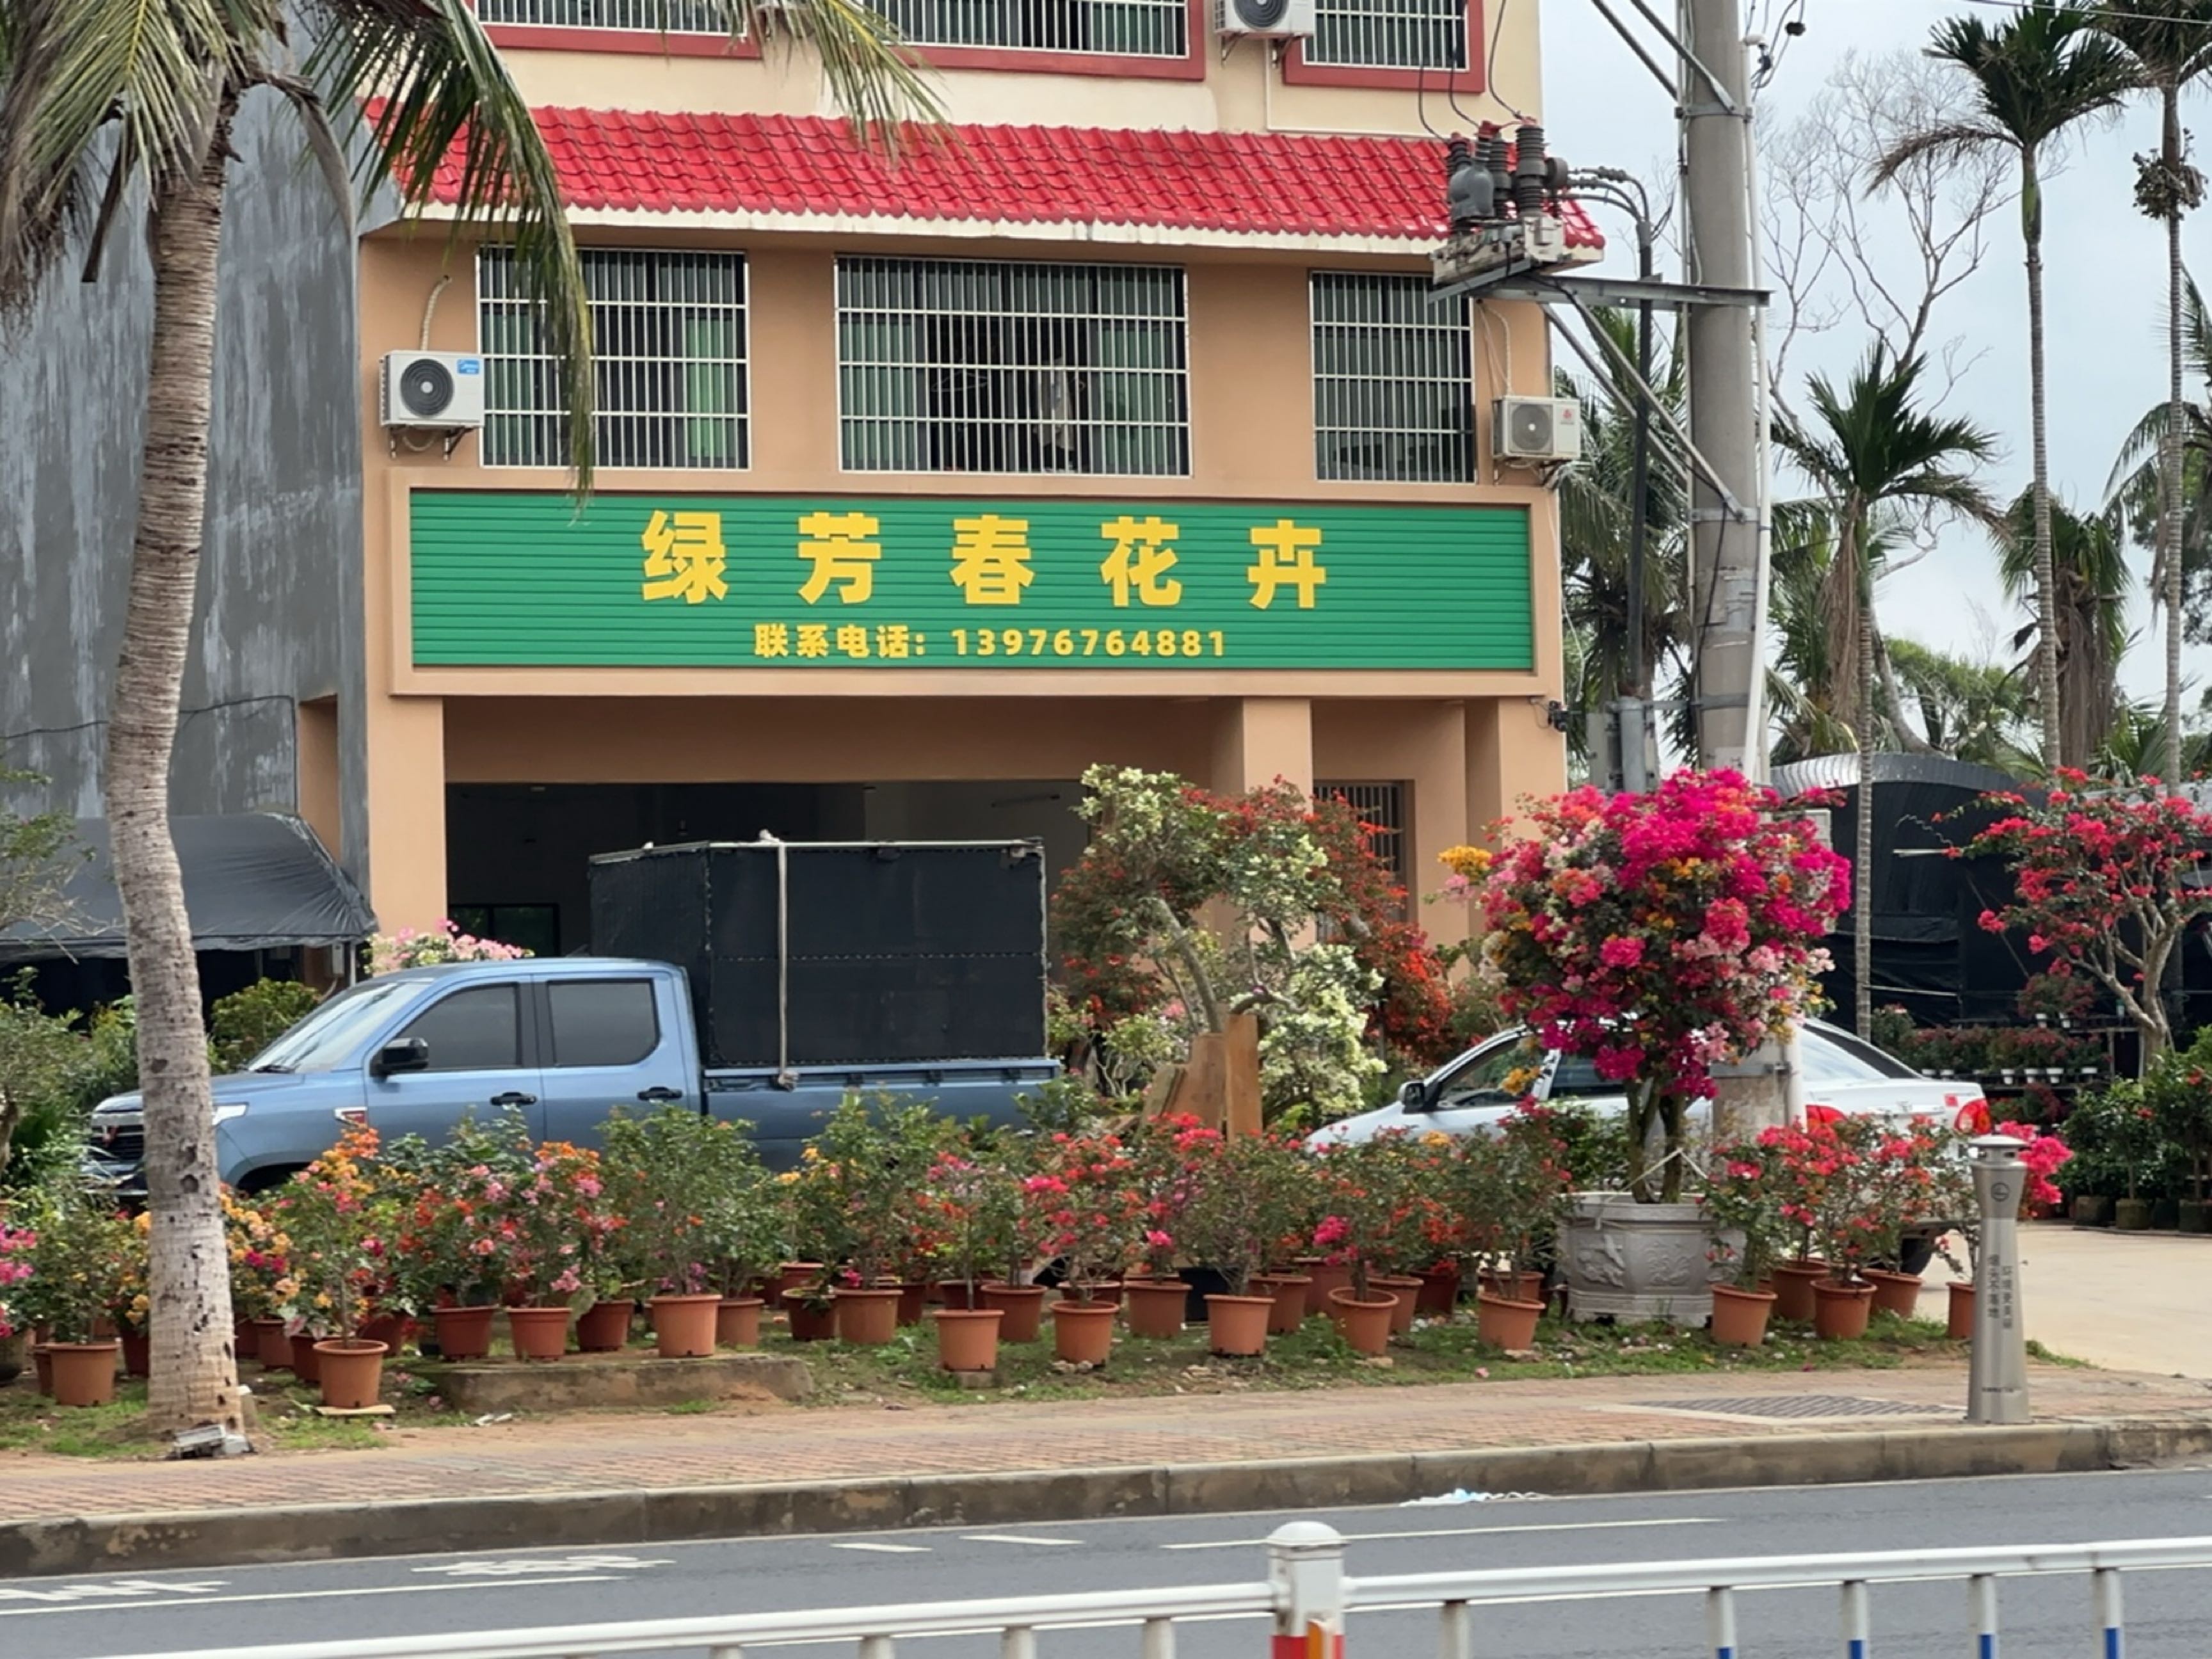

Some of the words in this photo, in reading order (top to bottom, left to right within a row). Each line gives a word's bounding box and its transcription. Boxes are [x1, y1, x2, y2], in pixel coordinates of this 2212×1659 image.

[641, 510, 1326, 609] 绿芳春花卉
